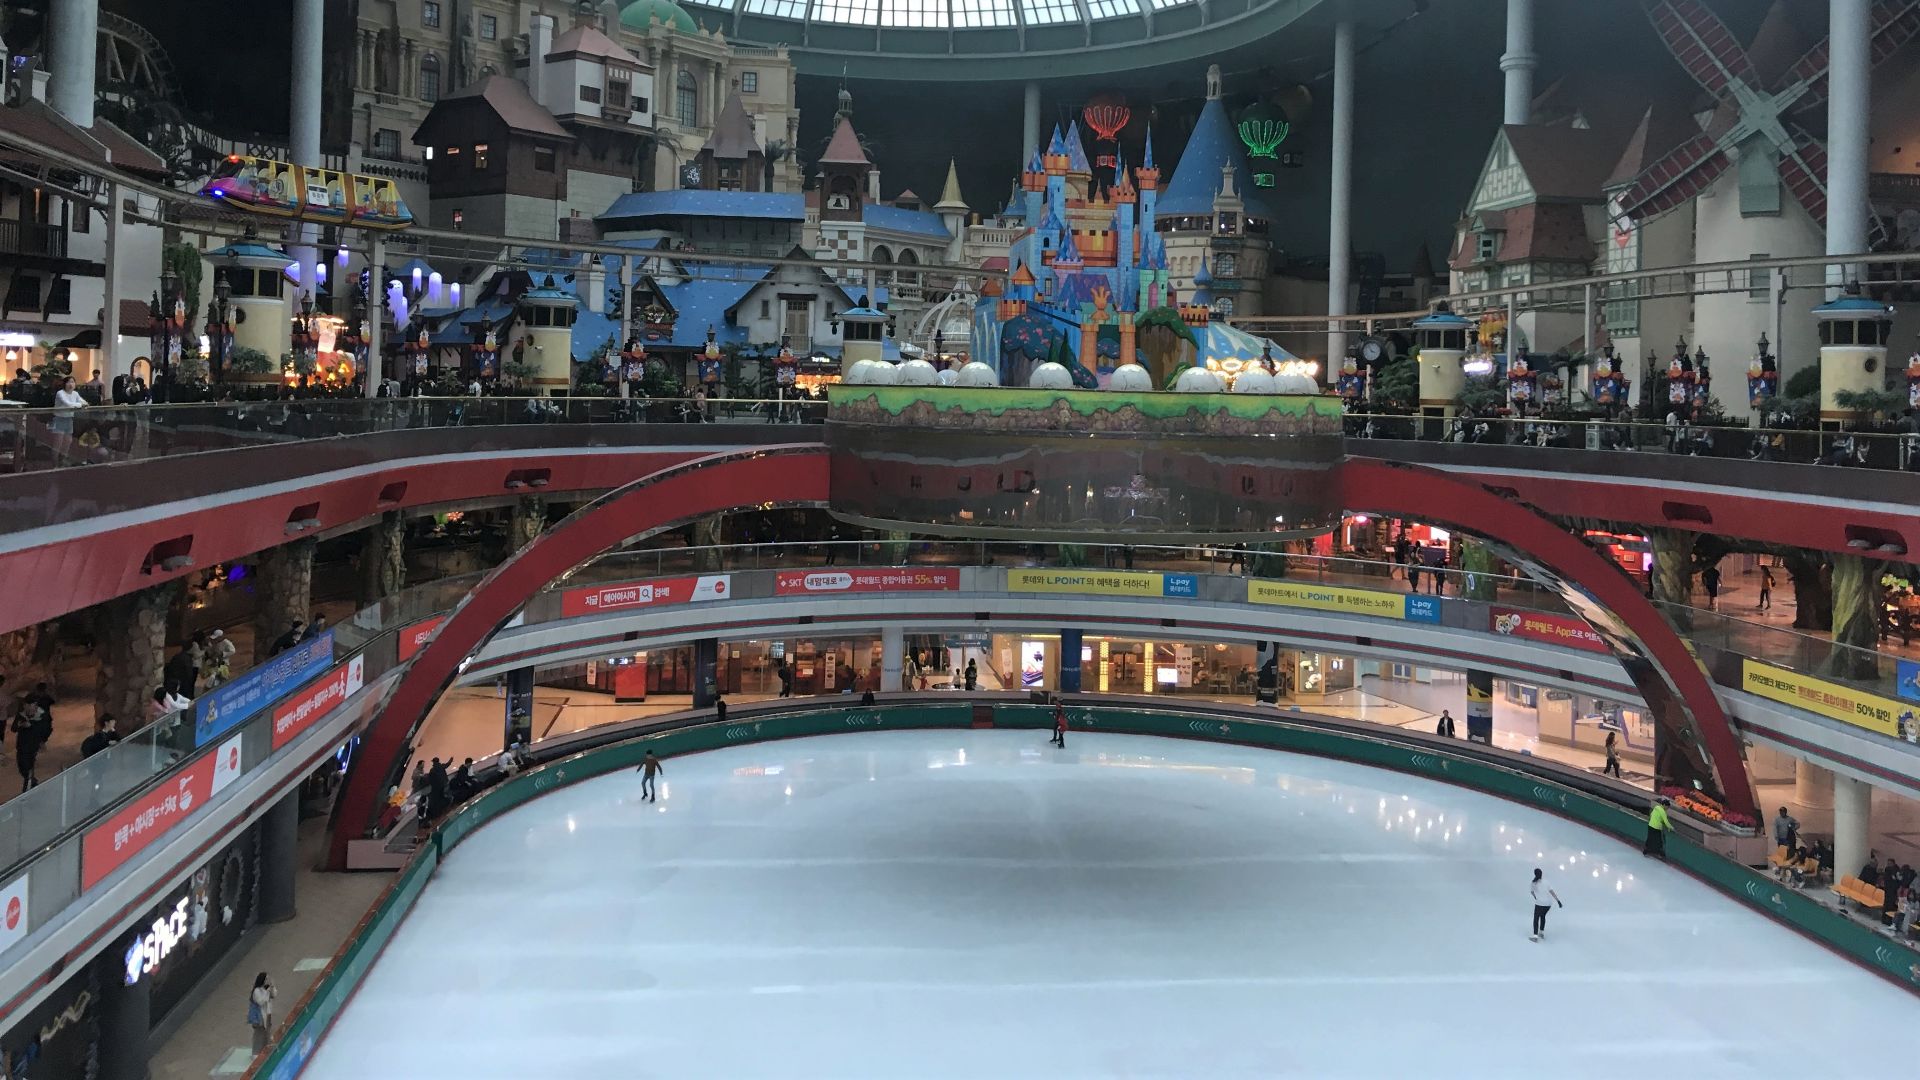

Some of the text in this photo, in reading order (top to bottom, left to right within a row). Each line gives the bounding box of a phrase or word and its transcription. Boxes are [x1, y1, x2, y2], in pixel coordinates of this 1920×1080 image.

[789, 579, 802, 587] SKT
[806, 577, 837, 586] 내맘대로
[856, 576, 880, 585] 롯데월드
[882, 575, 913, 584] 종합이용권
[915, 575, 932, 584] 55%
[933, 575, 946, 584] 할인
[1022, 576, 1044, 584] 롯데와
[1096, 578, 1120, 588] 혜택을
[1123, 579, 1150, 589] 더하다!
[585, 595, 598, 605] 지금
[604, 590, 636, 603] 에어아시아
[1258, 588, 1298, 598] 롯데마트에서
[1346, 596, 1372, 607] 득템하는
[1374, 599, 1395, 609] 노하우
[1411, 608, 1432, 616] 롯데카드
[1524, 619, 1554, 633] 롯데월드
[1555, 625, 1584, 638] App으로
[1748, 672, 1774, 688] 카카오뱅크
[1775, 680, 1796, 694] 체크카드
[1856, 703, 1875, 718] 50%
[1876, 709, 1890, 722] 할인
[143, 896, 189, 973] SPACE
